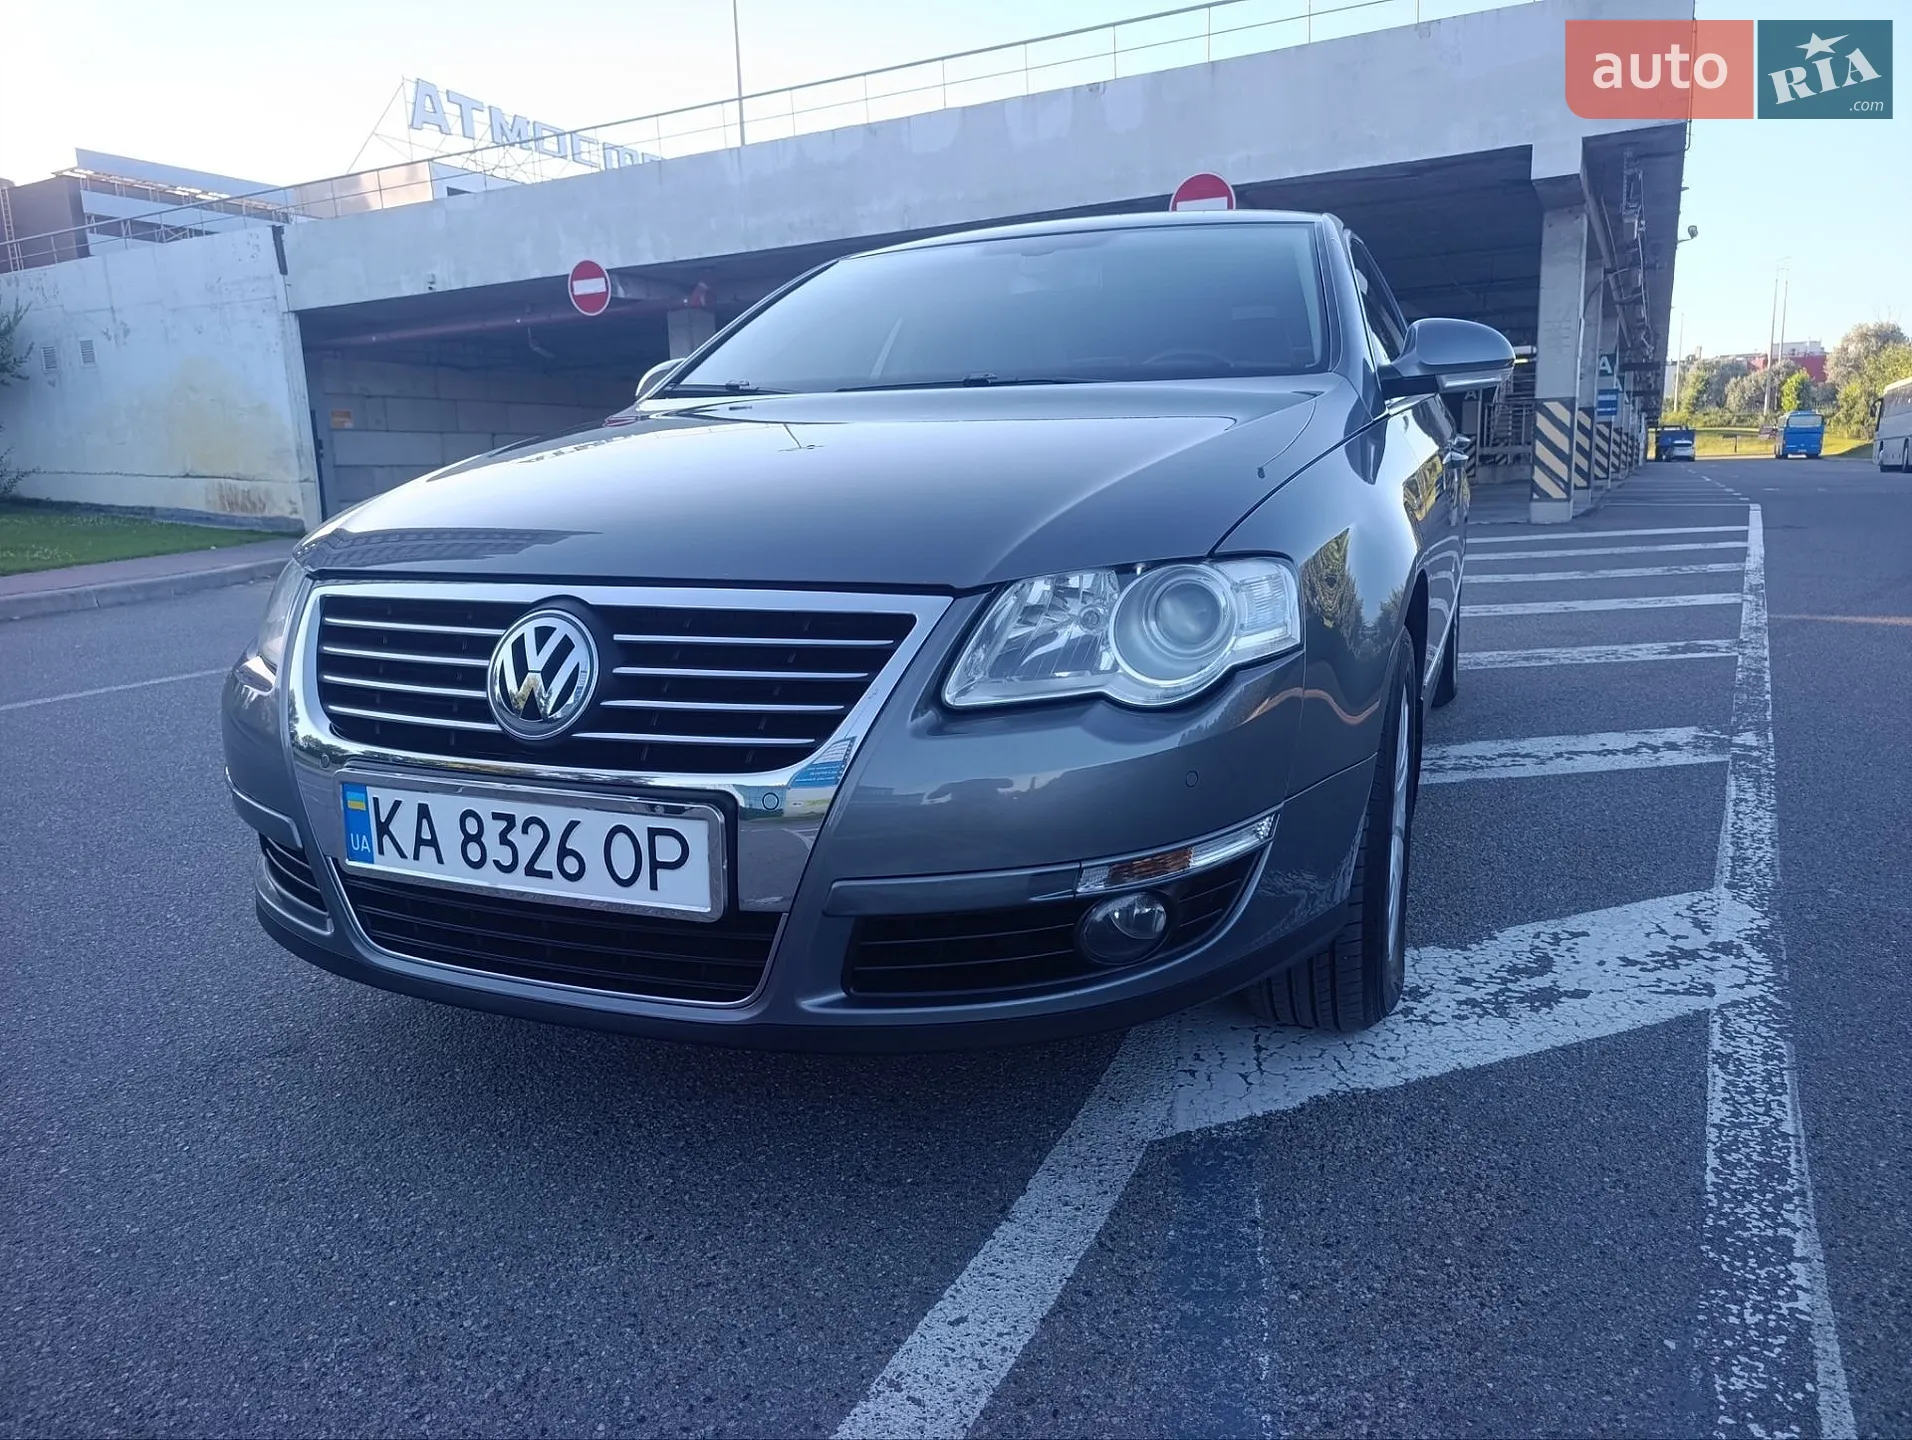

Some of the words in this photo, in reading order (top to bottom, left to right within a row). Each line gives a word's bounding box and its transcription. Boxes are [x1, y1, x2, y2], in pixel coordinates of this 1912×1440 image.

[350, 831, 371, 854] UA
[373, 796, 446, 866] KA
[459, 809, 587, 883] 8326
[603, 823, 690, 891] OP
